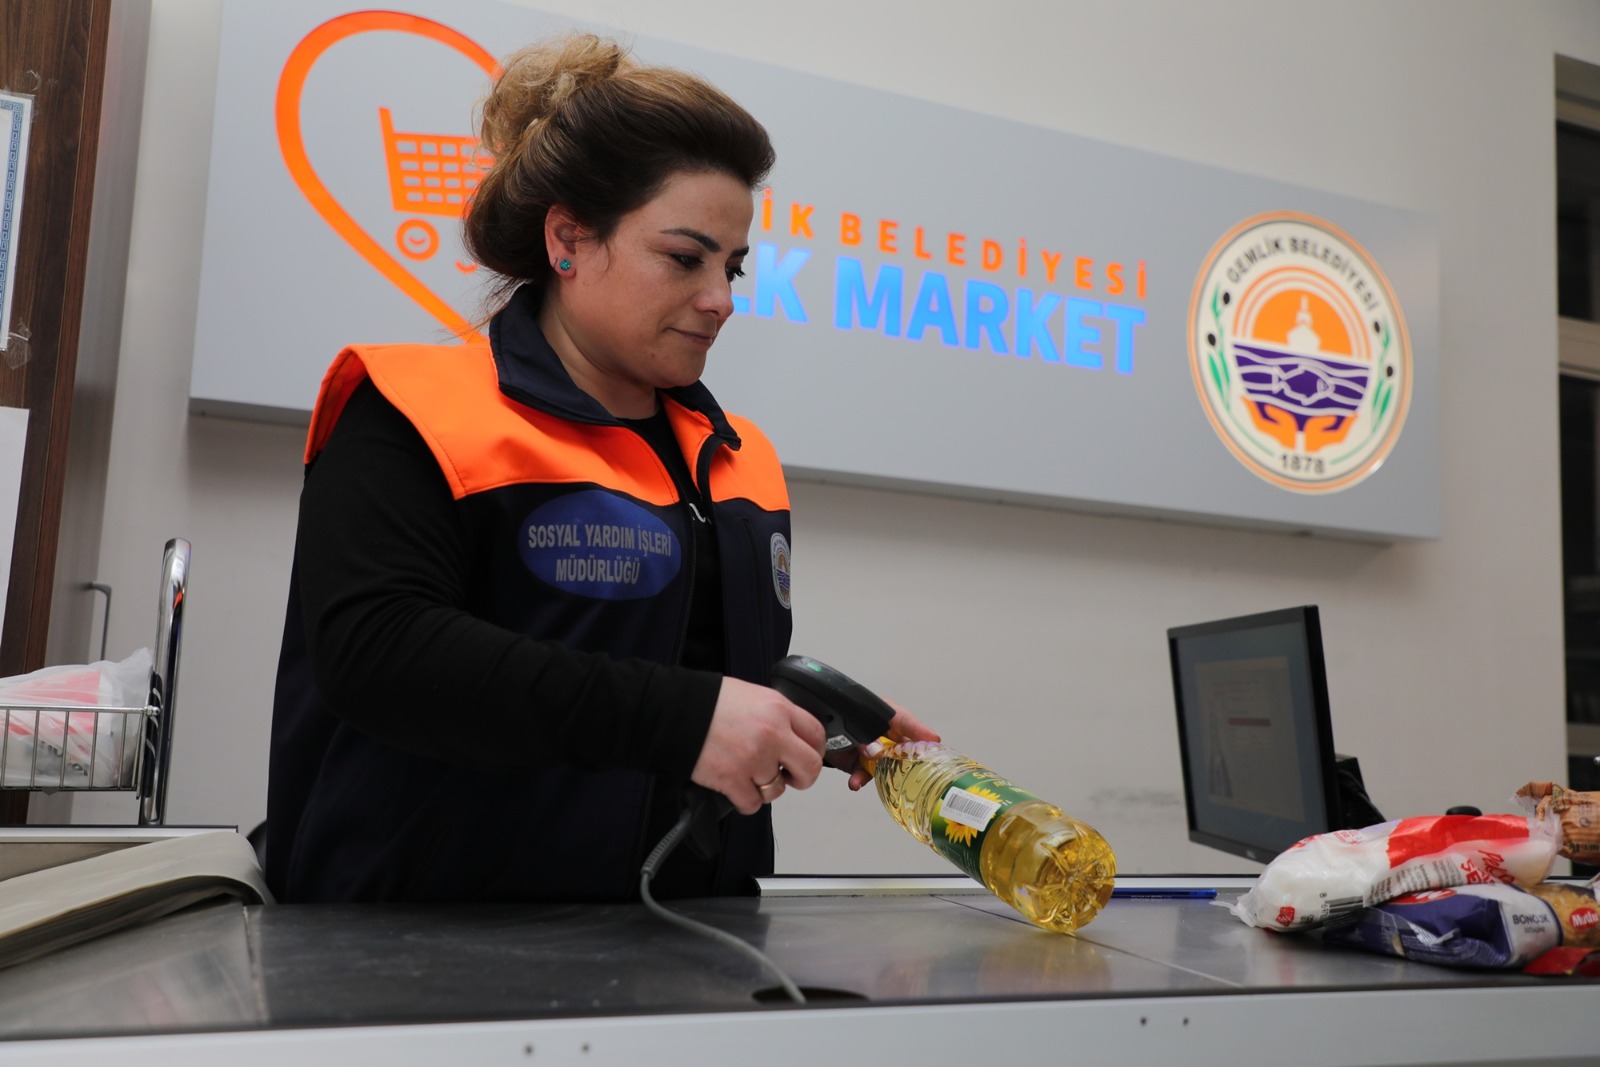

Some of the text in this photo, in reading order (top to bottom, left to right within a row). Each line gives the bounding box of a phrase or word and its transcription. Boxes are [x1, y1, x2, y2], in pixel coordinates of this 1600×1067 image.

[839, 211, 1148, 300] BELEDİYESİ
[1226, 236, 1380, 312] GEMLİK BELEDİYESİ
[834, 255, 1147, 375] MARKET
[1280, 454, 1326, 475] 1878
[528, 524, 672, 557] SOSYAL YARDIM İŞLERİ
[555, 554, 641, 585] MÜDÜRLÜĞÜ
